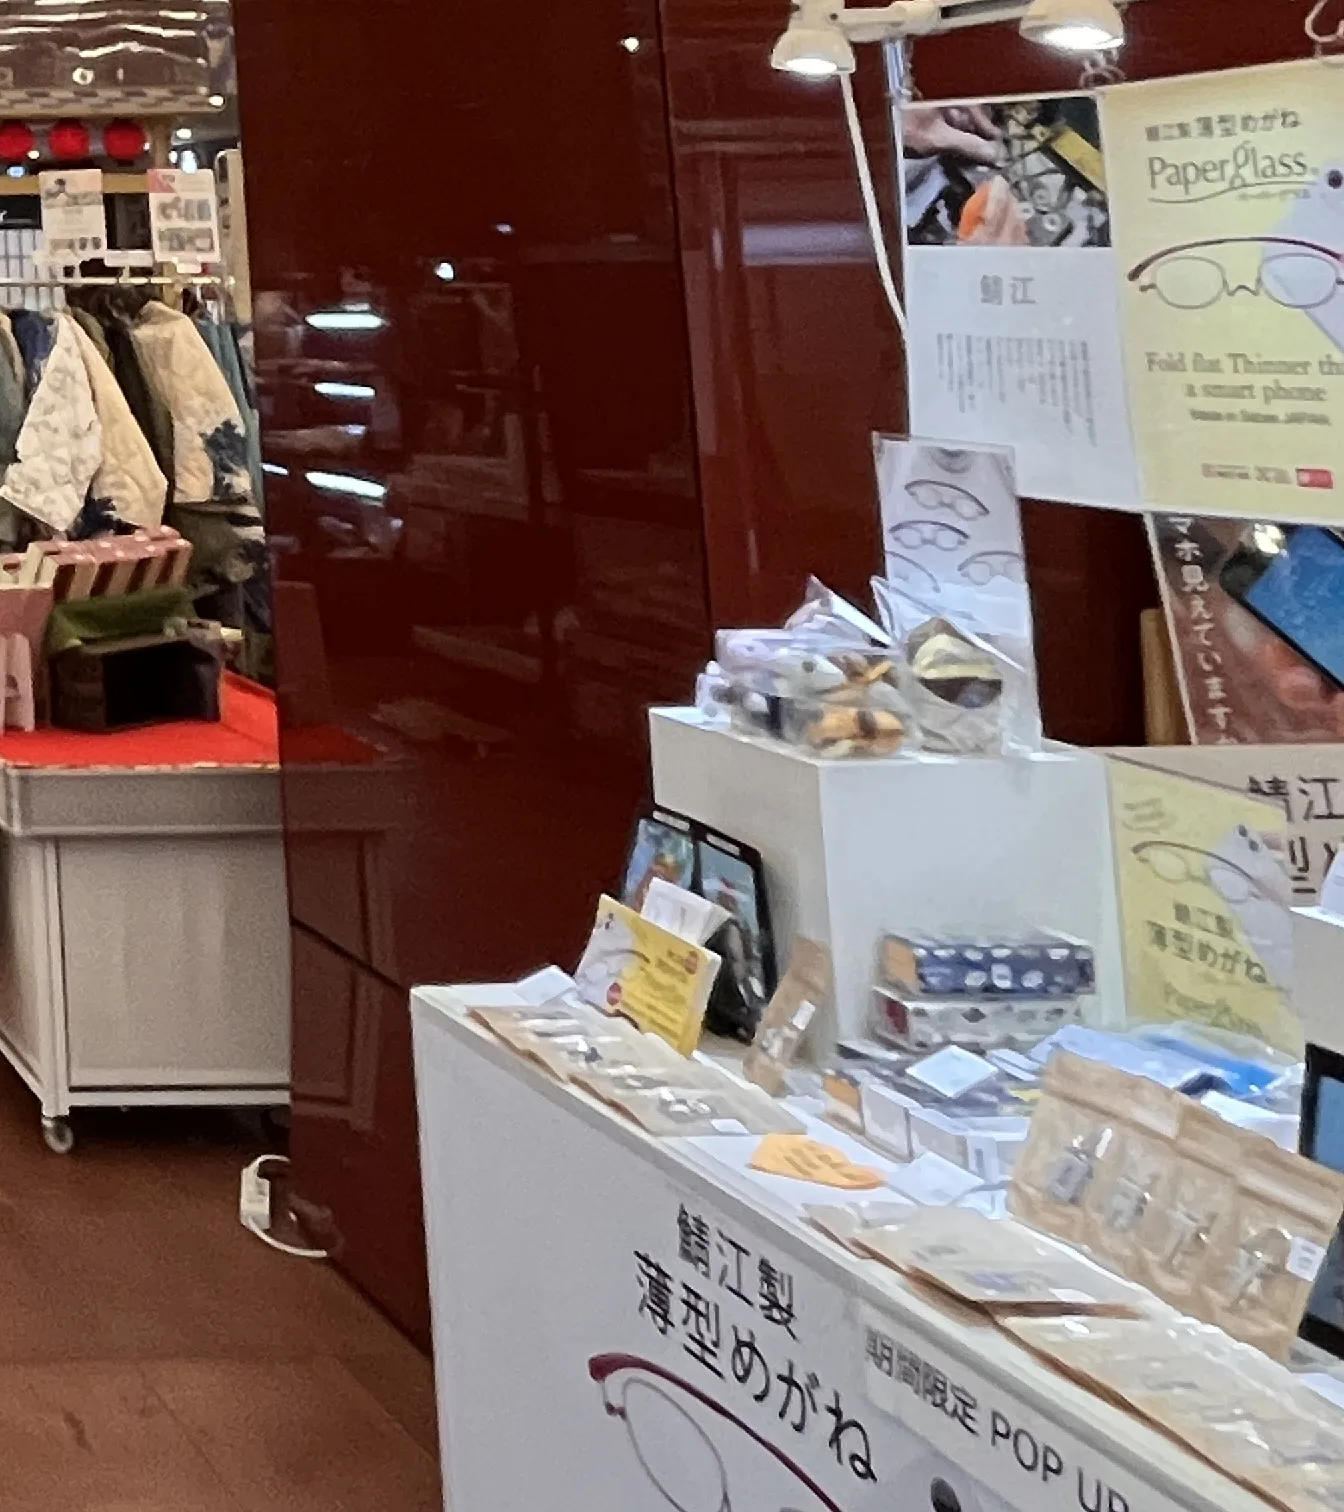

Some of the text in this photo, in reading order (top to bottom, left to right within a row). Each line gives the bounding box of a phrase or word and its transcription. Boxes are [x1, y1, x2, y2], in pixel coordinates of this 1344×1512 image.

[676, 1202, 801, 1343] 鯖江製
[632, 1250, 878, 1483] 薄型めがね
[865, 1326, 980, 1437] 期間限定
[990, 1409, 1064, 1483] POP
